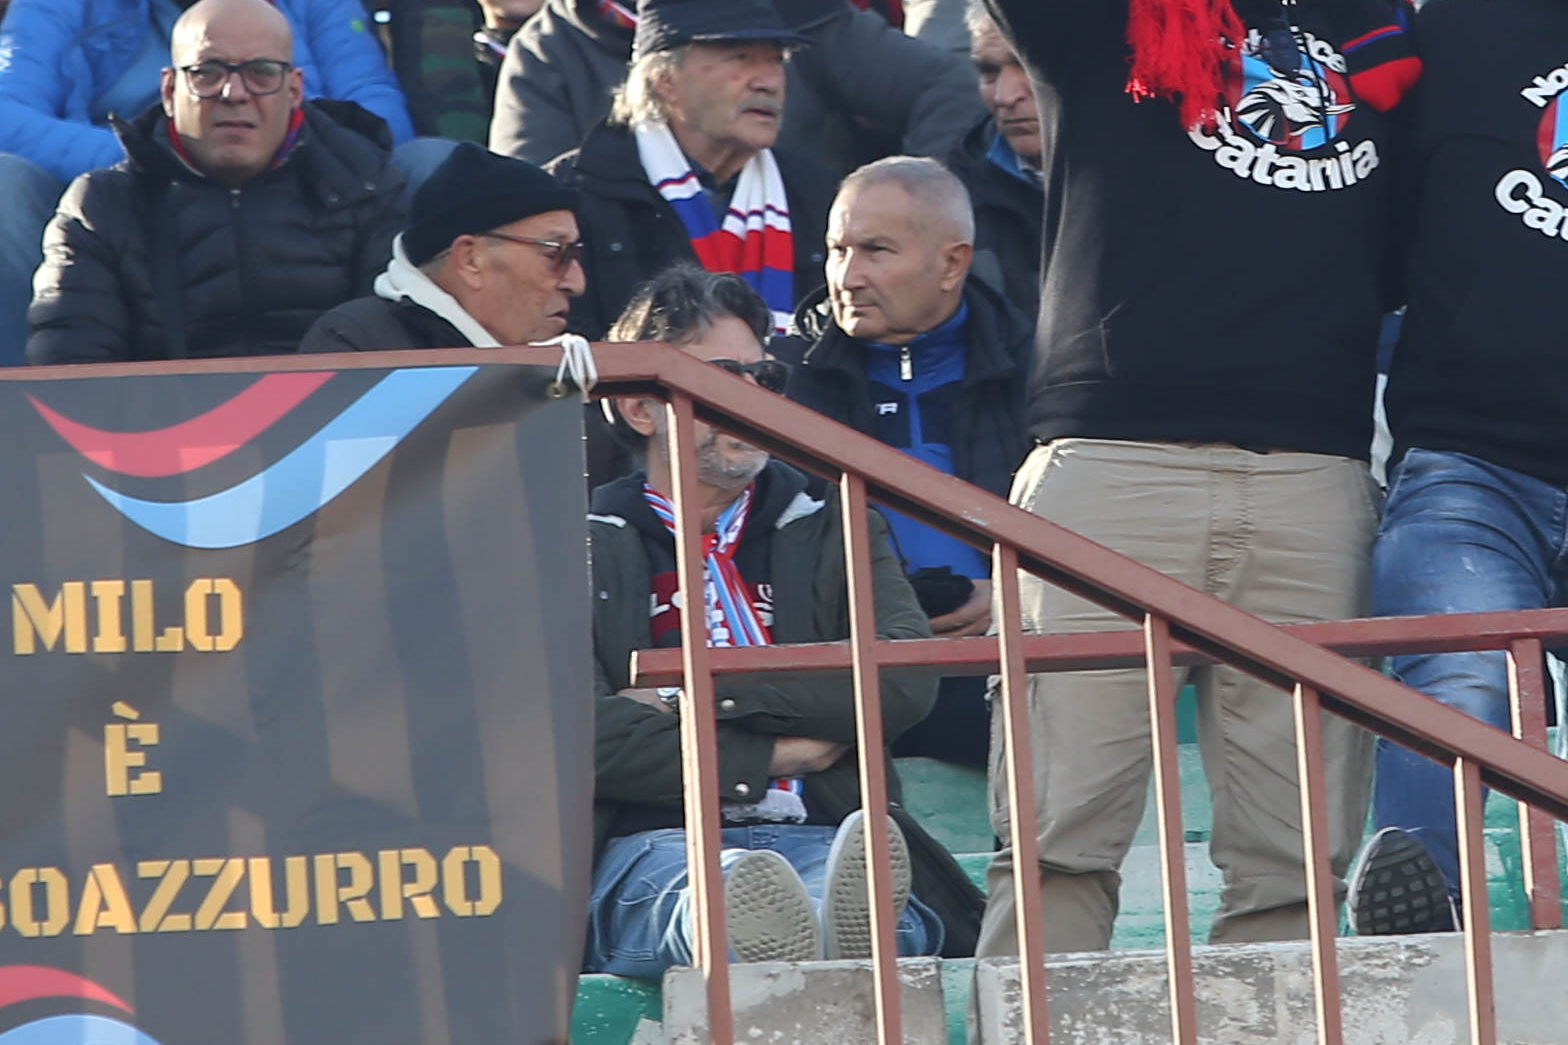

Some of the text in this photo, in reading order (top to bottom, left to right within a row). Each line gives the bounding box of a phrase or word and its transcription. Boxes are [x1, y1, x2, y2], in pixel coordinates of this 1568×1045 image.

[1187, 109, 1380, 192] Catania
[12, 578, 243, 654] MILO
[104, 701, 163, 797] È
[0, 845, 503, 938] OAZZURRO
